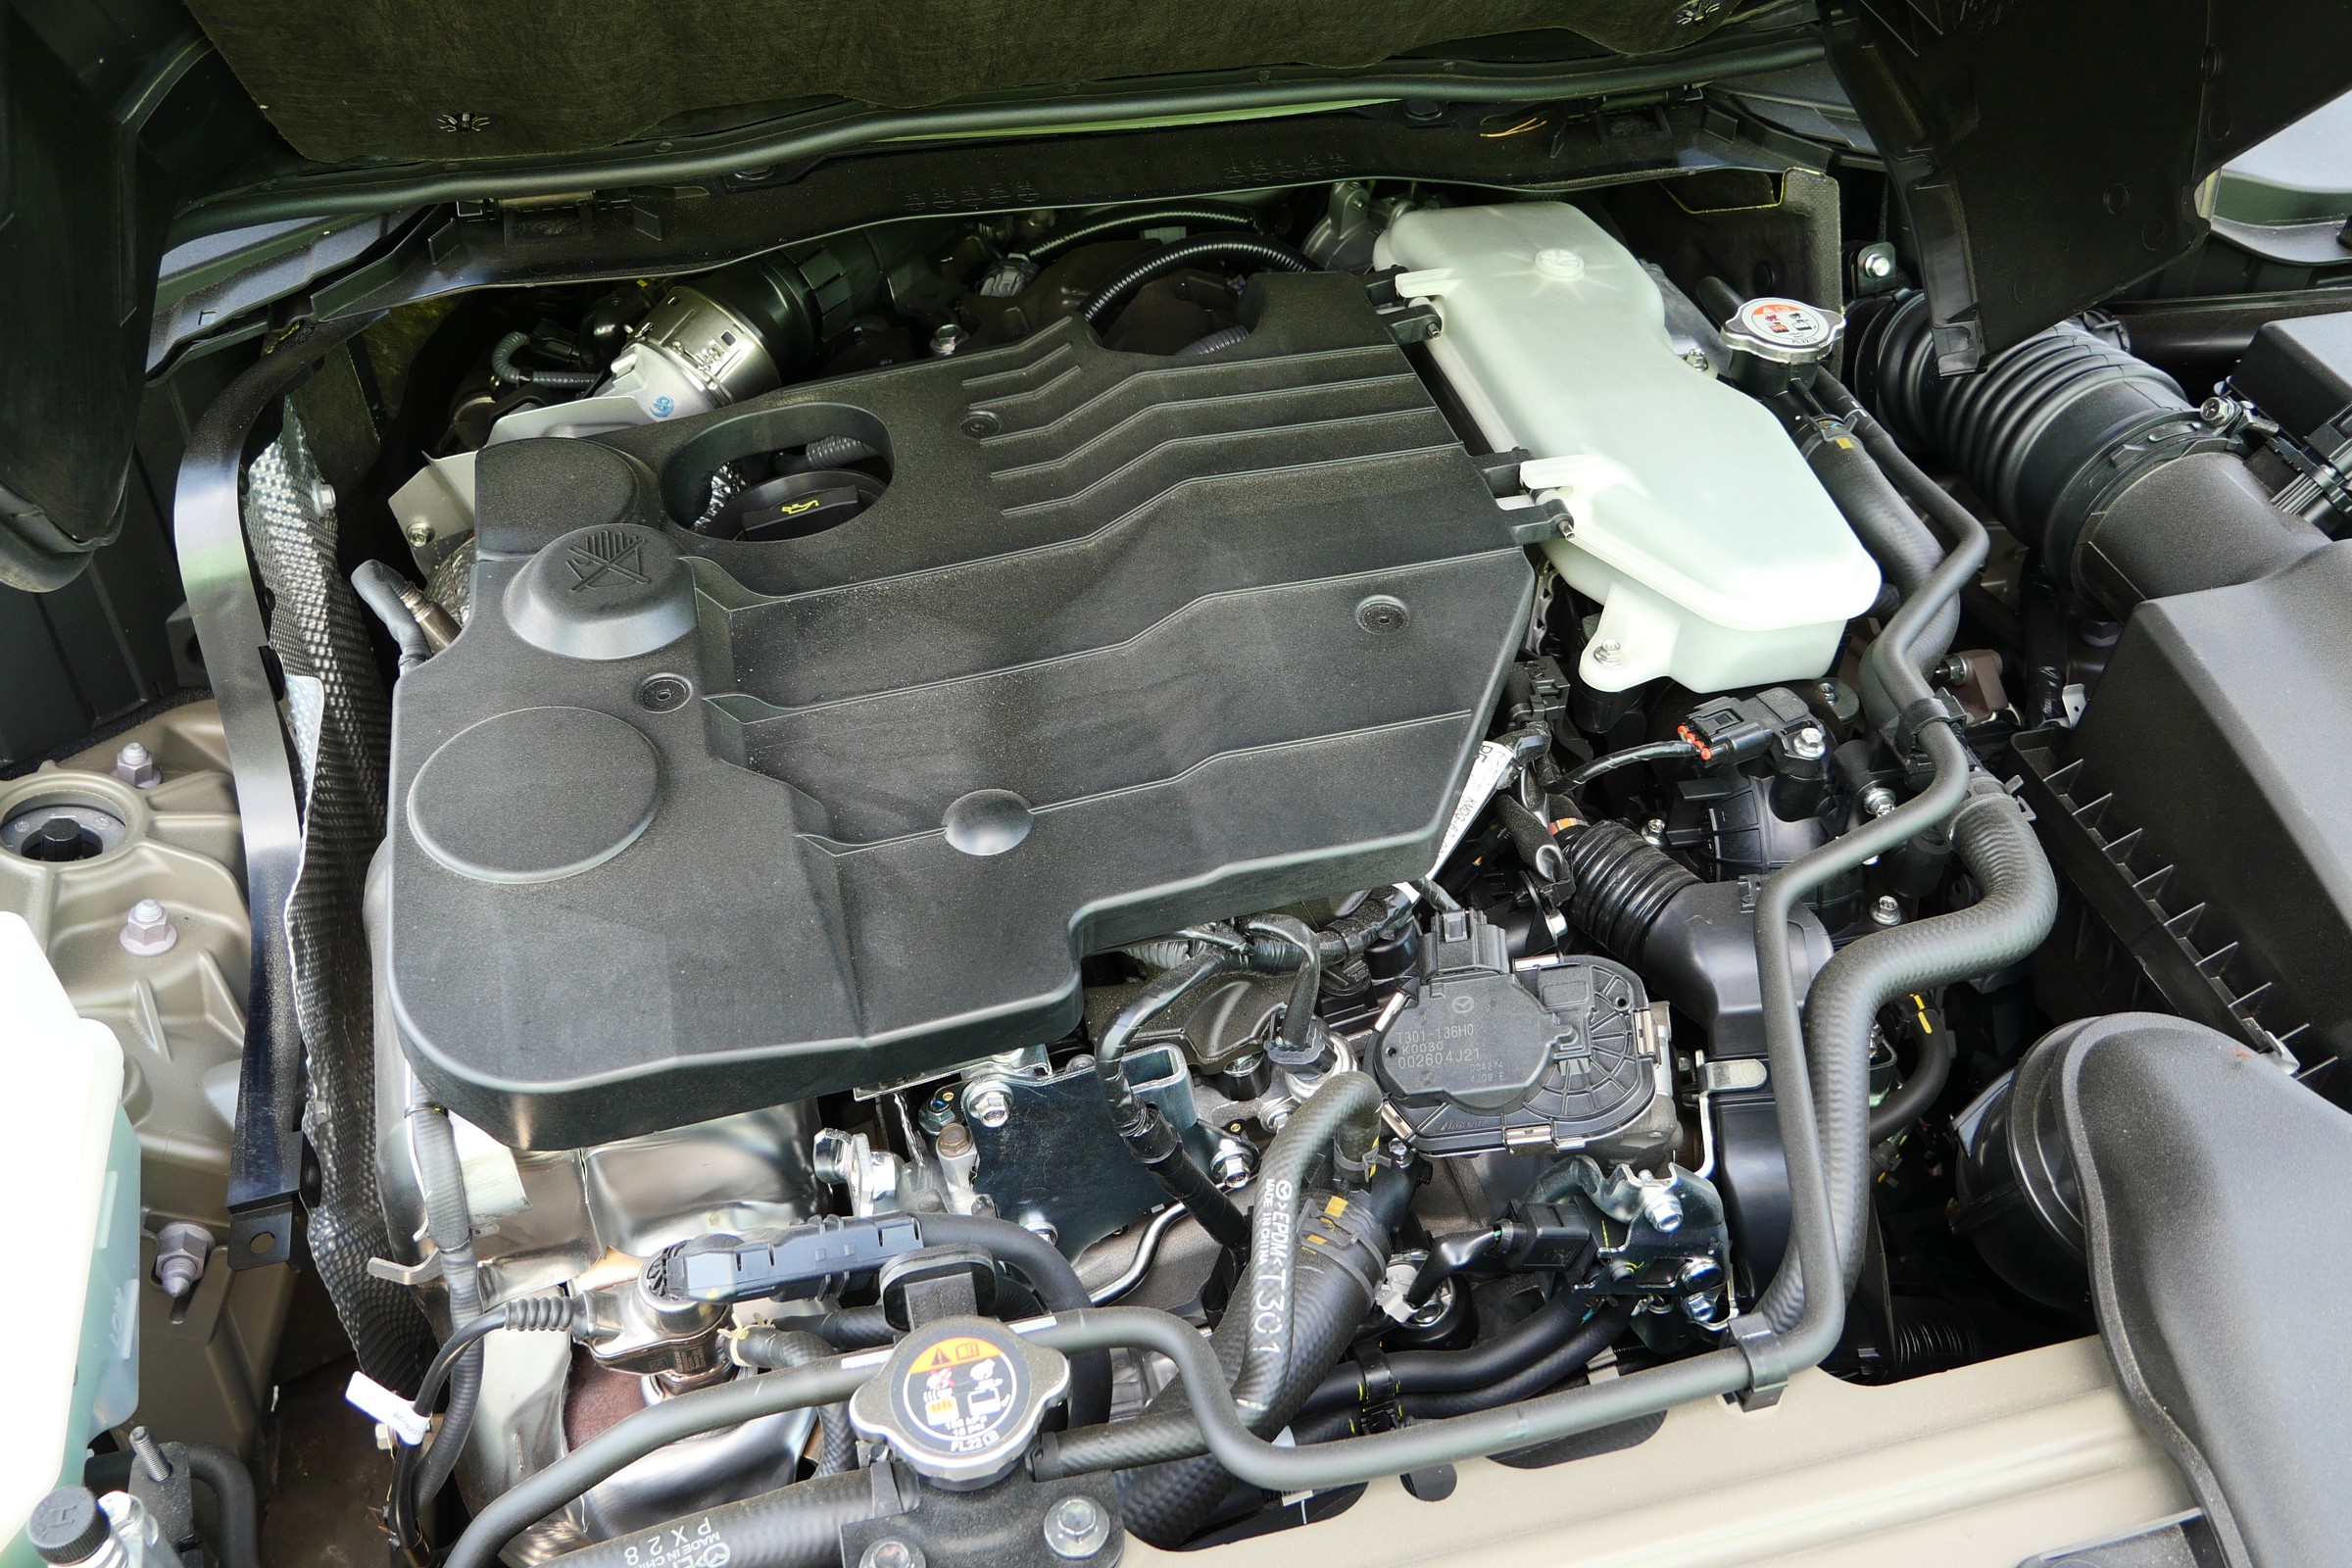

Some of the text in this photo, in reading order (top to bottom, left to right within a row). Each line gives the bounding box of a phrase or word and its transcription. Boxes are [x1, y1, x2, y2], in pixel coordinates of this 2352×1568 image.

[1396, 1023, 1475, 1045] T301-136H0
[1397, 1048, 1480, 1069] 002604J21
[1401, 1041, 1444, 1055] K0030
[1258, 1178, 1275, 1266] MADE IN CHINA
[951, 1437, 983, 1452] FL22
[681, 1531, 721, 1555] MADE
[666, 1548, 681, 1562] IN
